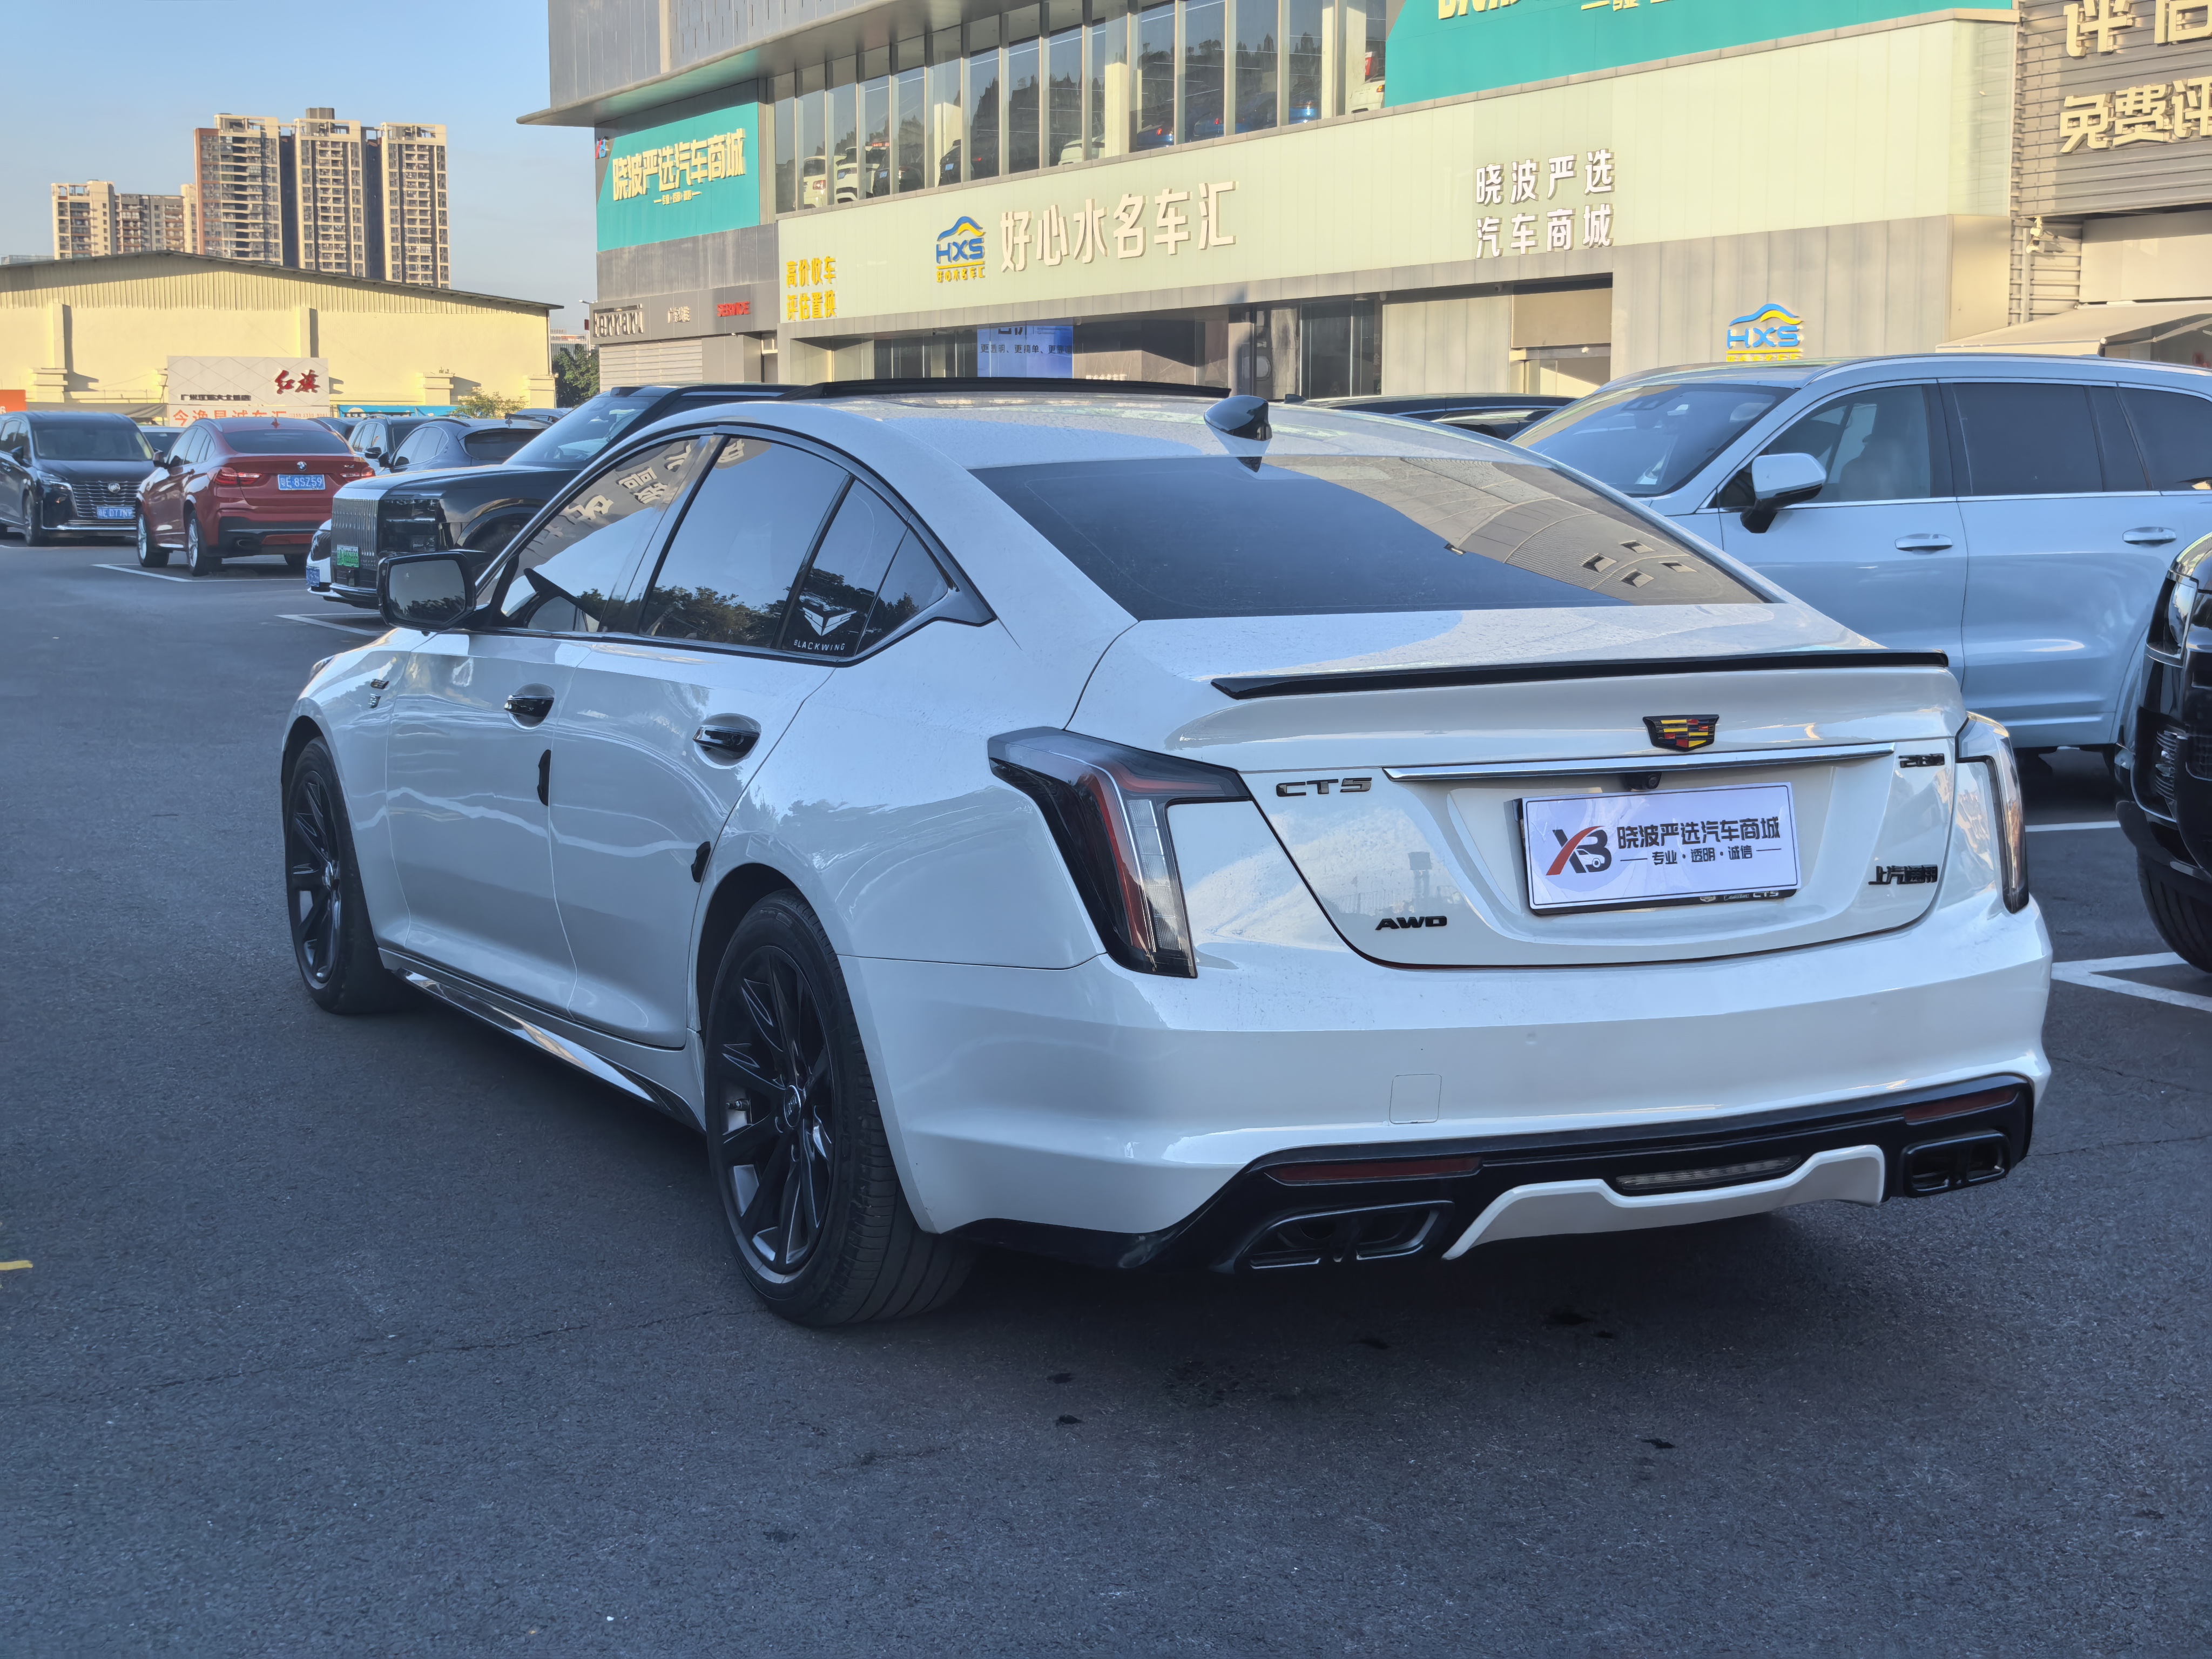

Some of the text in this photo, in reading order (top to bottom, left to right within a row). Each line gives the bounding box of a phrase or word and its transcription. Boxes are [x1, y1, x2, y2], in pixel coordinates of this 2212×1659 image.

[612, 128, 745, 201] 晓波严选汽车商城
[1475, 149, 1615, 205] 晓波严选
[1000, 181, 1238, 272] 好心水名车汇
[1475, 204, 1614, 259] 汽车商城
[936, 238, 985, 264] HXS
[786, 256, 836, 288] 高价收车
[717, 301, 750, 317] SERVICE
[786, 290, 837, 321] 评估置换
[1727, 326, 1804, 349] HXS
[794, 639, 845, 651] BLACKWING
[1617, 816, 1781, 849] 晓波严选汽车商城
[1375, 915, 1447, 930] AWD
